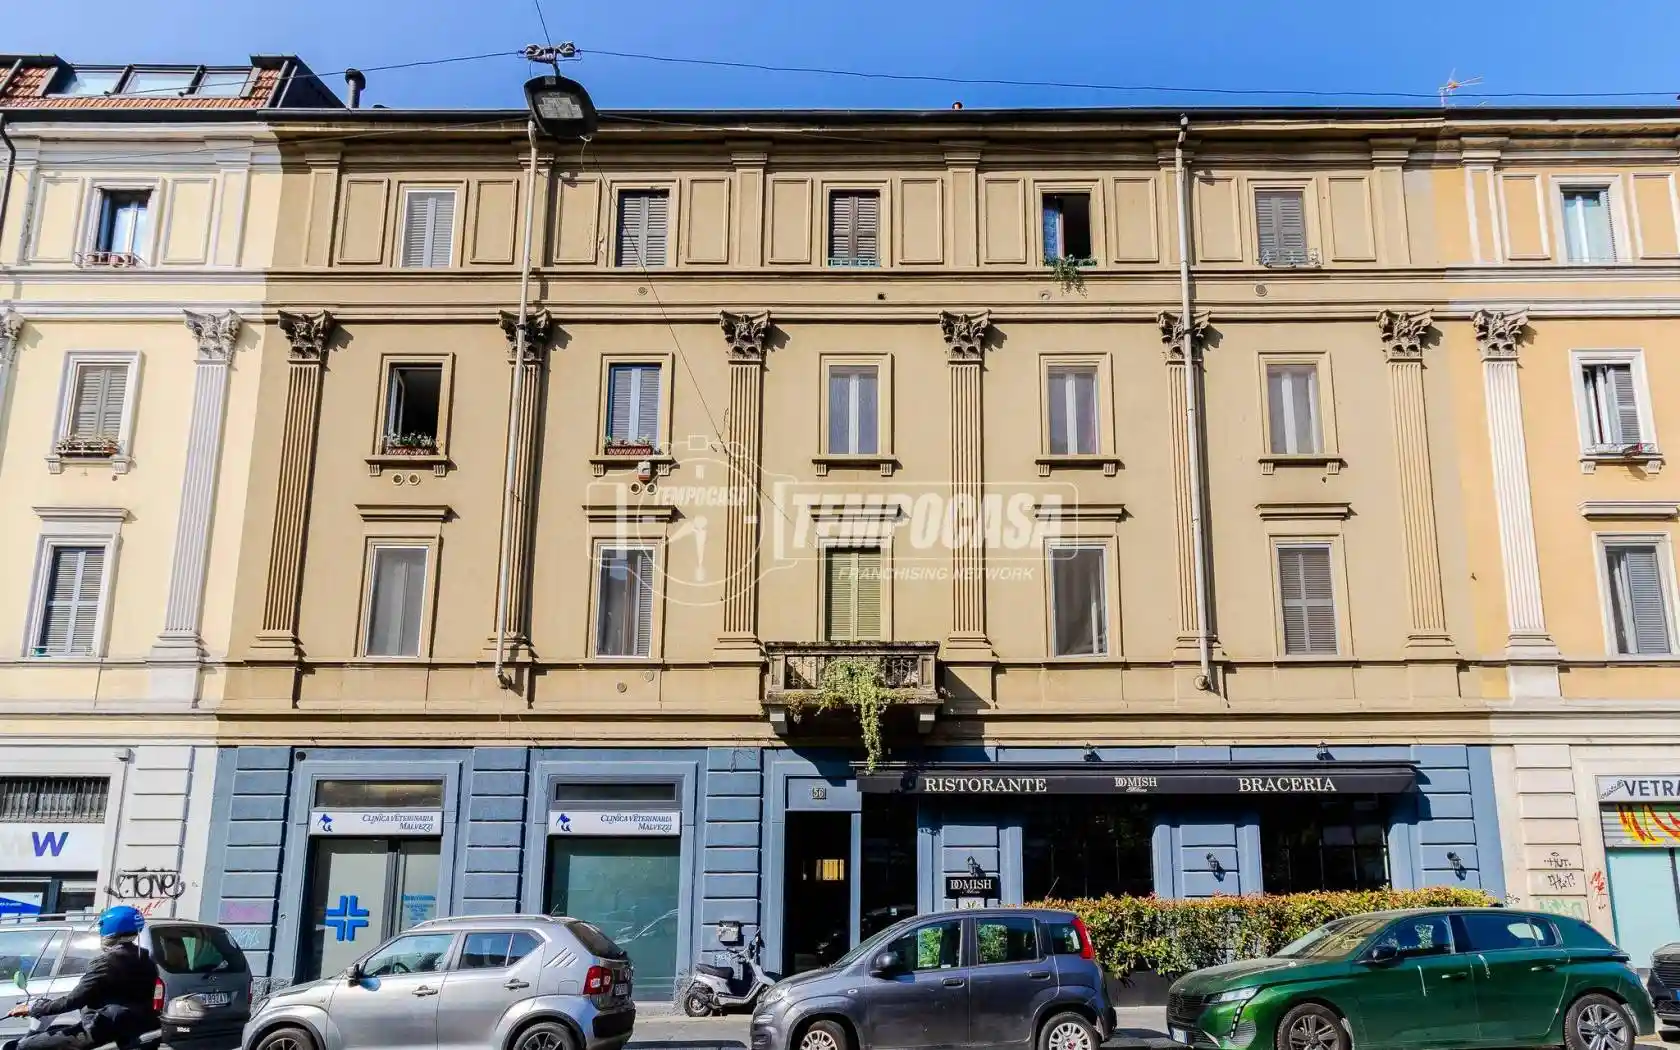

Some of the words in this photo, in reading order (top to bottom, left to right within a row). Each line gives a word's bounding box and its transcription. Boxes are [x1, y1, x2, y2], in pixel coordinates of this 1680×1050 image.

[924, 778, 1047, 792] RISTORANTE
[1239, 777, 1337, 792] BRACERIA
[1624, 780, 1680, 796] VETR
